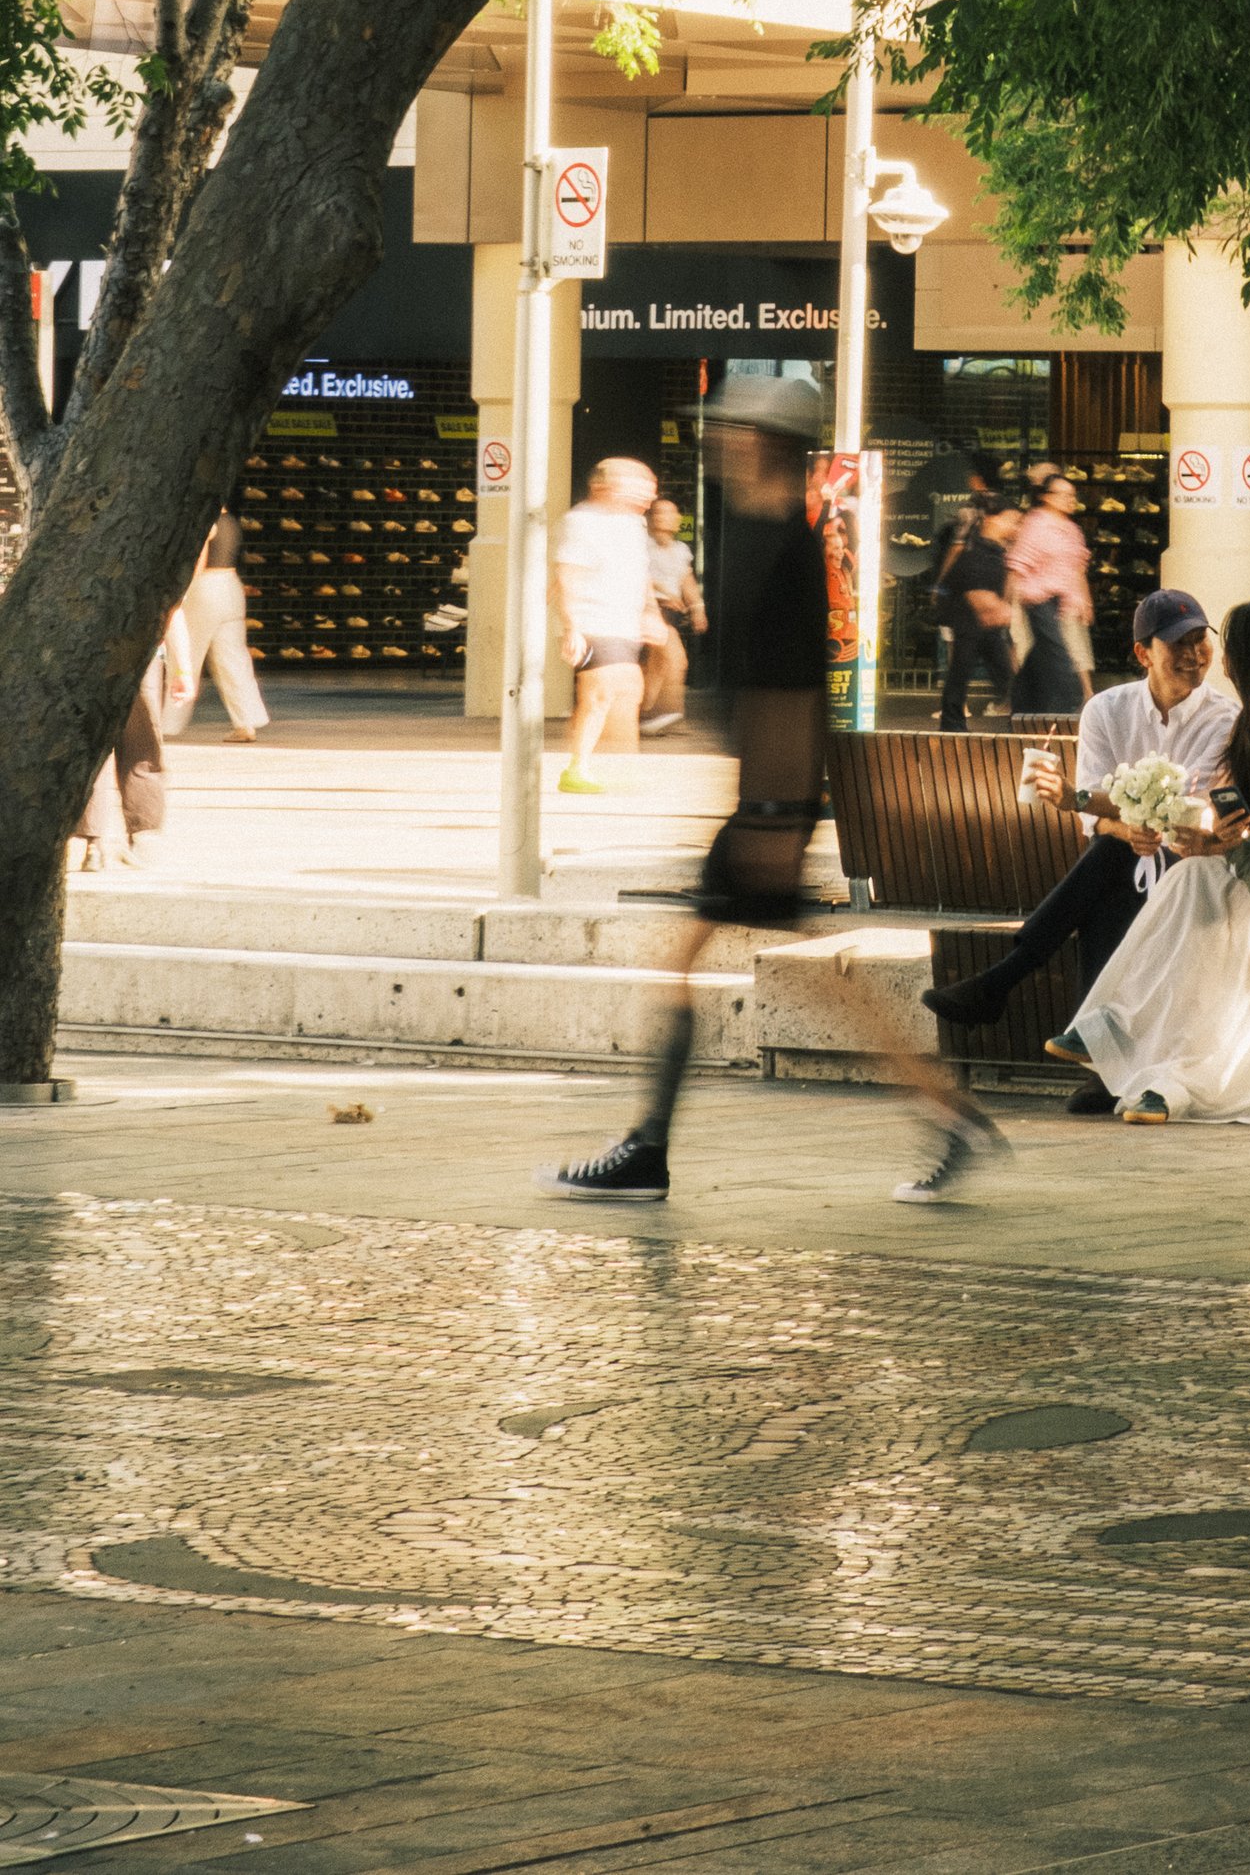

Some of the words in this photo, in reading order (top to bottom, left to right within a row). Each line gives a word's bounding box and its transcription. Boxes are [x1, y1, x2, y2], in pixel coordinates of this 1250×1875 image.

[568, 239, 584, 251] NO
[552, 255, 599, 267] SMOKING
[649, 303, 750, 330] Limited.
[758, 303, 887, 330] Excluse.
[321, 372, 415, 399] Exclusive.
